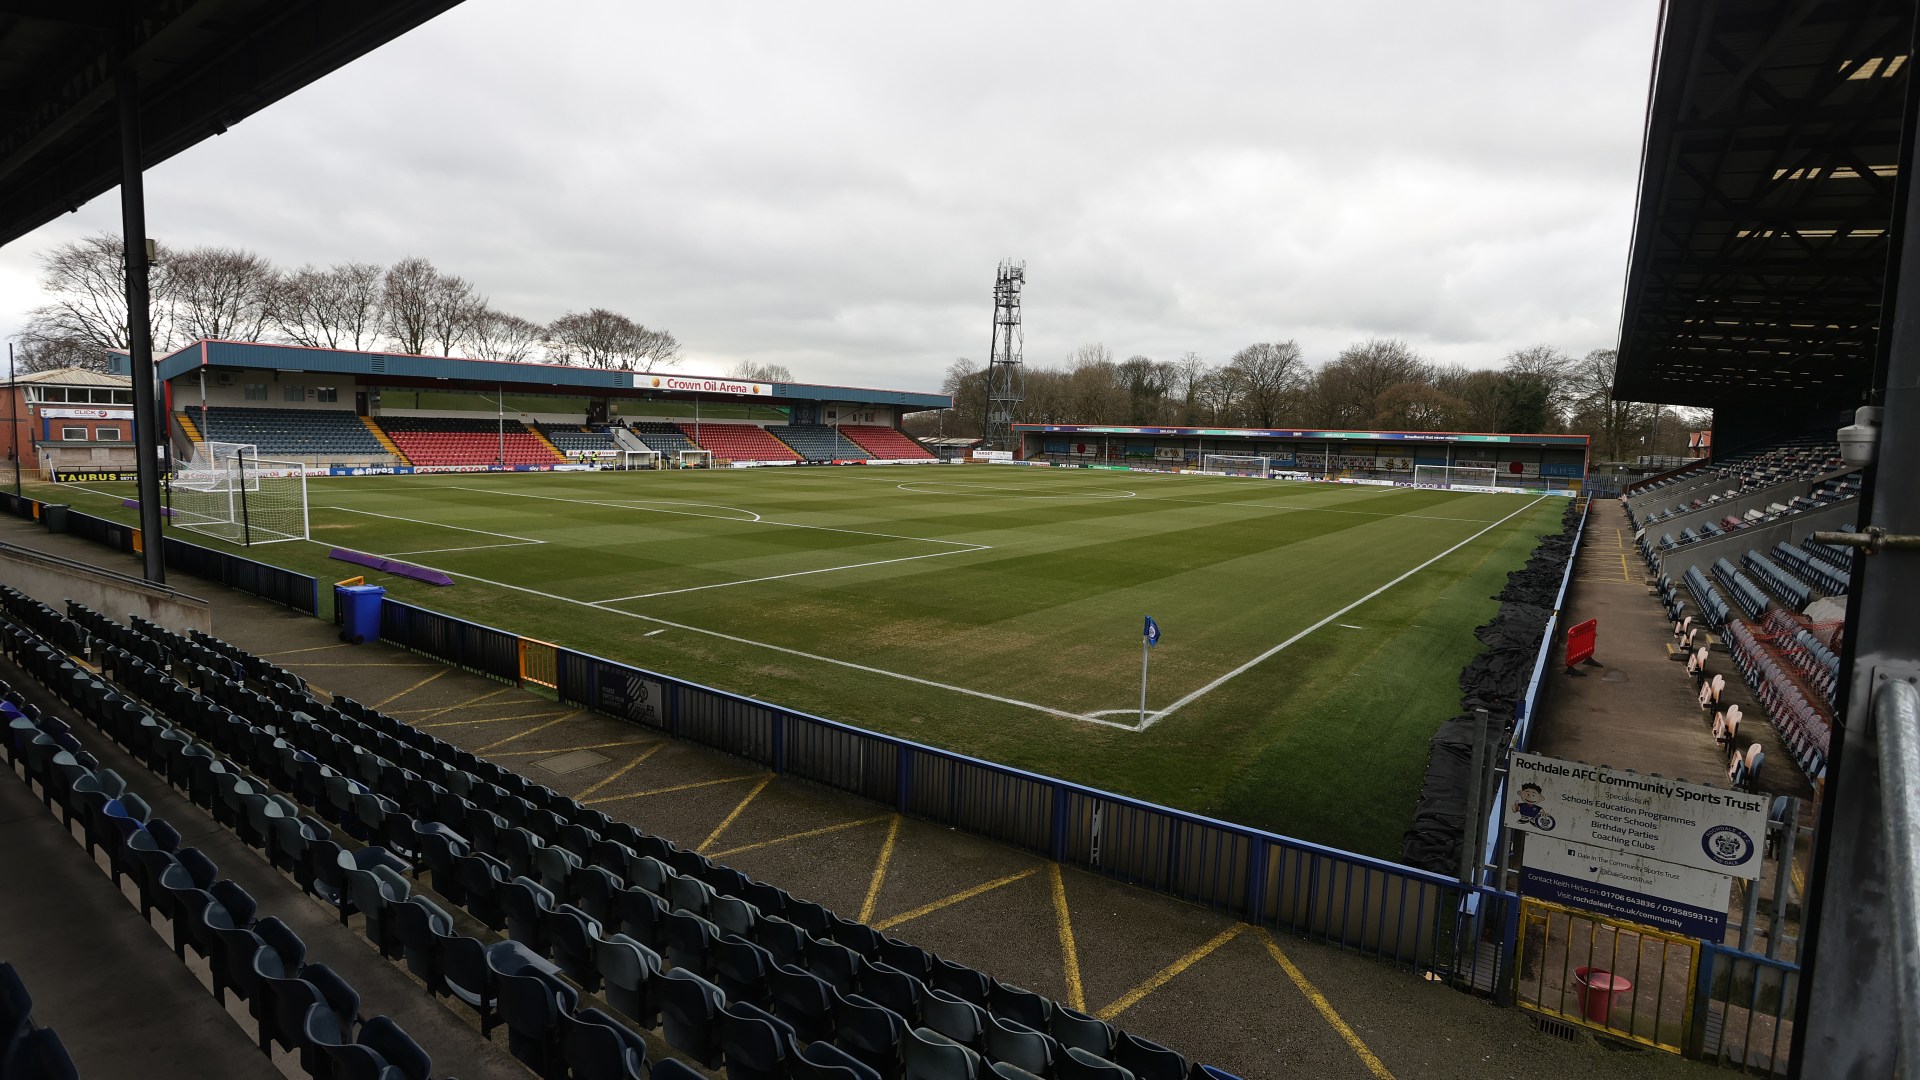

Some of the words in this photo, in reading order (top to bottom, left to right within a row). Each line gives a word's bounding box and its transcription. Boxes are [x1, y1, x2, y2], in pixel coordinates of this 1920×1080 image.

[667, 378, 700, 390] Crown
[704, 380, 716, 391] Oil
[720, 382, 746, 393] Arena
[58, 473, 116, 481] TAURUS
[1551, 466, 1576, 474] NHS
[1516, 758, 1569, 776] Rochdale
[1572, 768, 1596, 781] AFC
[1598, 773, 1673, 798] Community
[1676, 787, 1721, 804] Sports
[1724, 796, 1761, 812] Trust
[1562, 793, 1593, 806] Schools
[1595, 800, 1636, 815] Education
[1639, 809, 1696, 826] Programmes
[1595, 811, 1622, 822] Soccer
[1624, 816, 1657, 829] Schools
[1591, 820, 1626, 835] Birthday
[1628, 829, 1658, 840] Parties
[1705, 826, 1736, 837] ROCHDALE
[1592, 831, 1630, 846] Coaching
[1631, 840, 1655, 850] Clubs
[1609, 860, 1643, 872] Community
[1644, 867, 1664, 876] Sports
[1665, 872, 1680, 880] Trust
[1528, 874, 1553, 884] Contact
[1554, 879, 1569, 888] Keith
[1571, 882, 1588, 892] Hicks
[1600, 890, 1624, 900] 01706
[1626, 896, 1655, 909] 643836
[1662, 906, 1718, 924] 07958593121
[1573, 896, 1682, 927] rochdaleafc.co.uk/community
